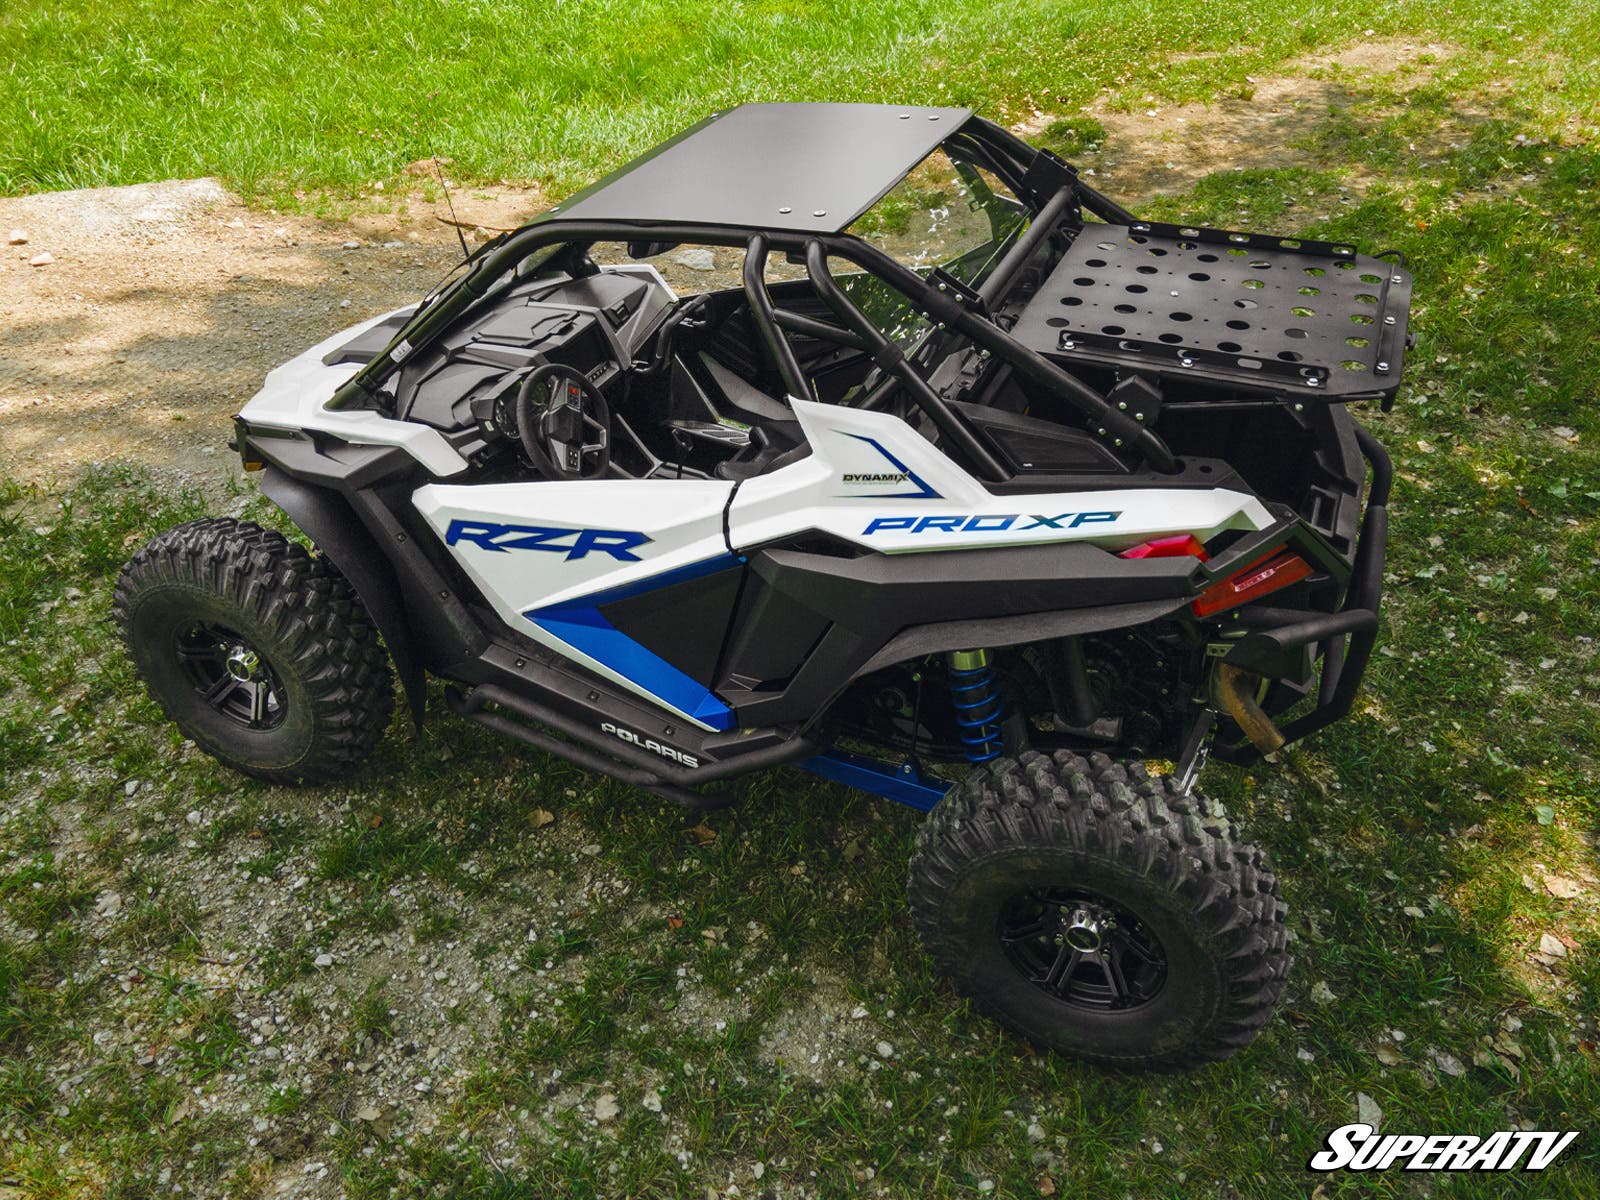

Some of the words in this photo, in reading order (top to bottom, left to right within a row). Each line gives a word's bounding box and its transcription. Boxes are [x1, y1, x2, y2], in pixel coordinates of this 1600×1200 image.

[842, 471, 910, 484] DYNAMIX
[861, 513, 1021, 535] PRO
[1017, 511, 1123, 530] XP
[445, 519, 656, 562] RZR
[601, 722, 699, 769] POLARIS
